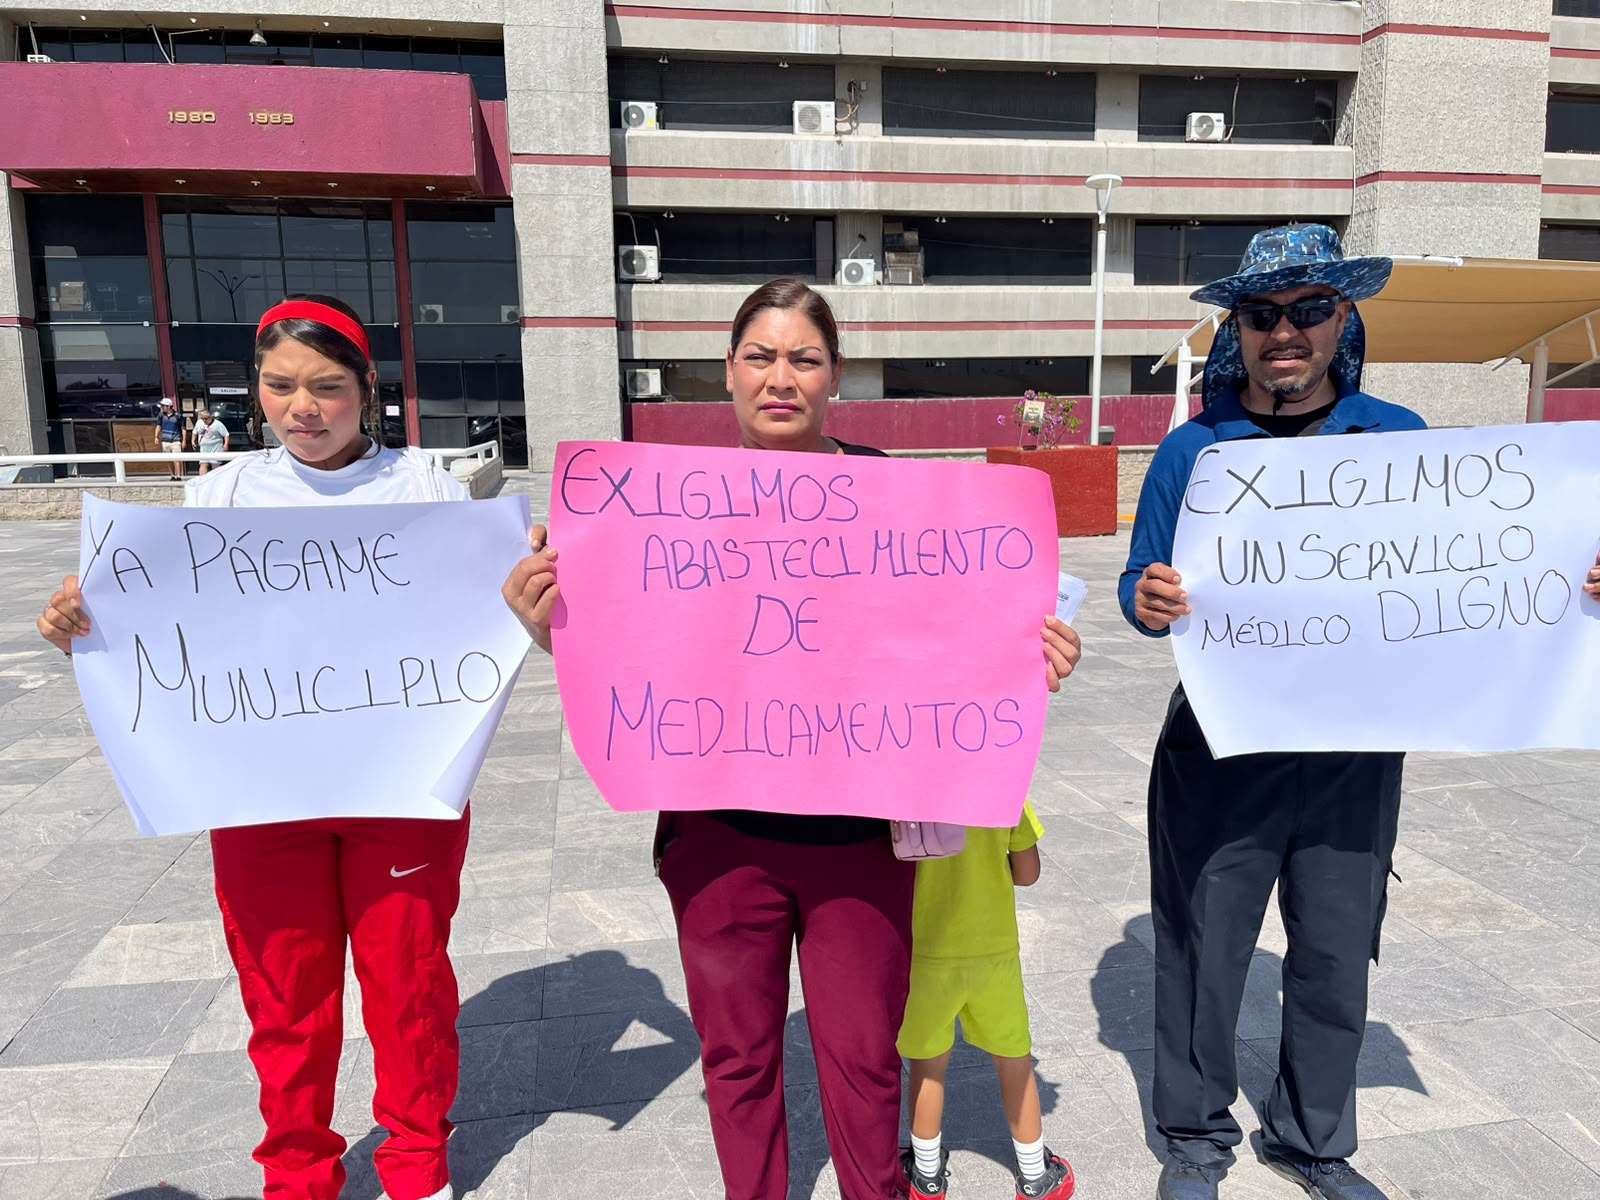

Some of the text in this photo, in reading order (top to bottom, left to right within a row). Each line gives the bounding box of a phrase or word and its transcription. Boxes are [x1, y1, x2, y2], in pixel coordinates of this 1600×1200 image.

[168, 111, 294, 125] 1980 1983
[561, 448, 859, 523] EXIGIMOS
[1185, 443, 1535, 515] EXIGIMOS
[80, 515, 410, 595] YA PÁGAME
[643, 525, 1034, 592] ABASTECIMIENTO
[1217, 525, 1534, 585] UN SERVICIO
[743, 594, 820, 656] DE
[1202, 569, 1571, 650] MÉDICO DIGNO
[132, 623, 501, 732] MUNICIPIO
[607, 681, 1024, 761] MEDICAMENTOS
